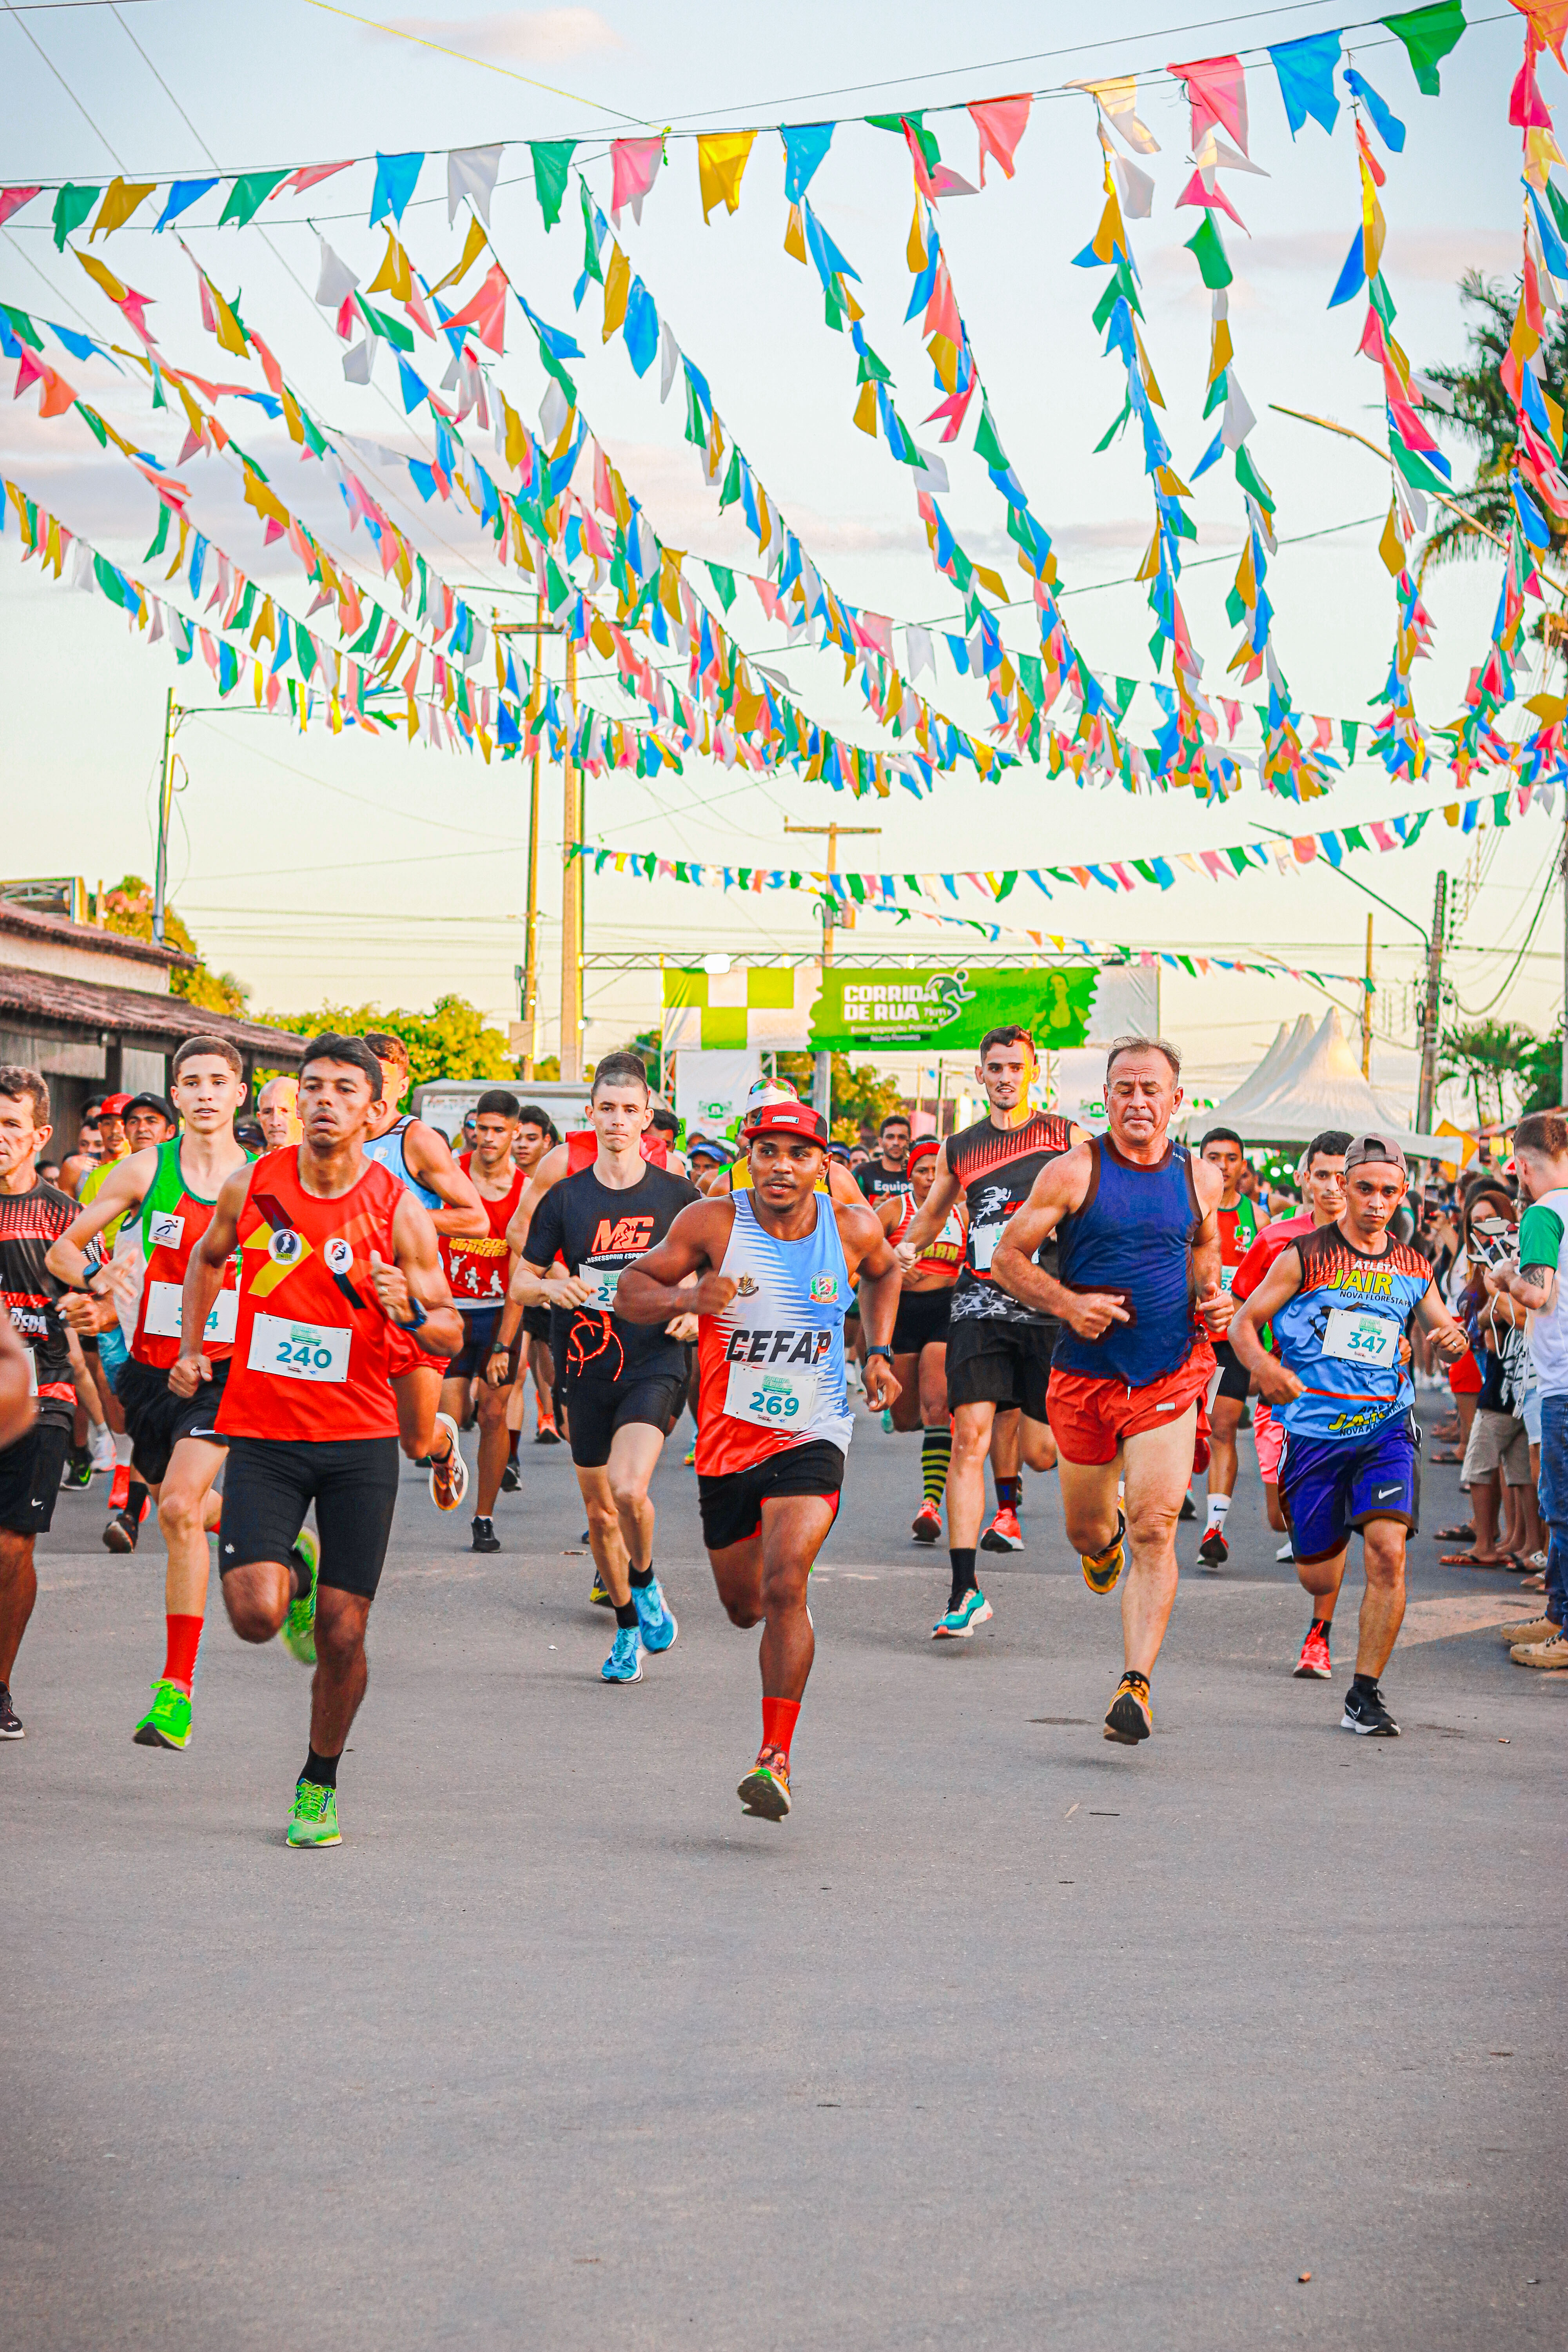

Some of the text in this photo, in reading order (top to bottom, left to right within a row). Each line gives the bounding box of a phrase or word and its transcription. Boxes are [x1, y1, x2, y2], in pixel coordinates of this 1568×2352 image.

[844, 985, 939, 1002] CORRIDA
[844, 1004, 920, 1020] DE RUA
[591, 1216, 654, 1252] MG
[587, 1254, 623, 1263] ASSESSORIA
[1353, 1260, 1398, 1274] ATLETA
[1327, 1269, 1393, 1295] JAIR
[1340, 1291, 1363, 1299] NOVA
[725, 1329, 832, 1364] CEFAP
[1347, 1332, 1387, 1354] 347
[276, 1342, 332, 1368] 240
[750, 1392, 799, 1416] 269
[1340, 1427, 1364, 1436] NOVA
